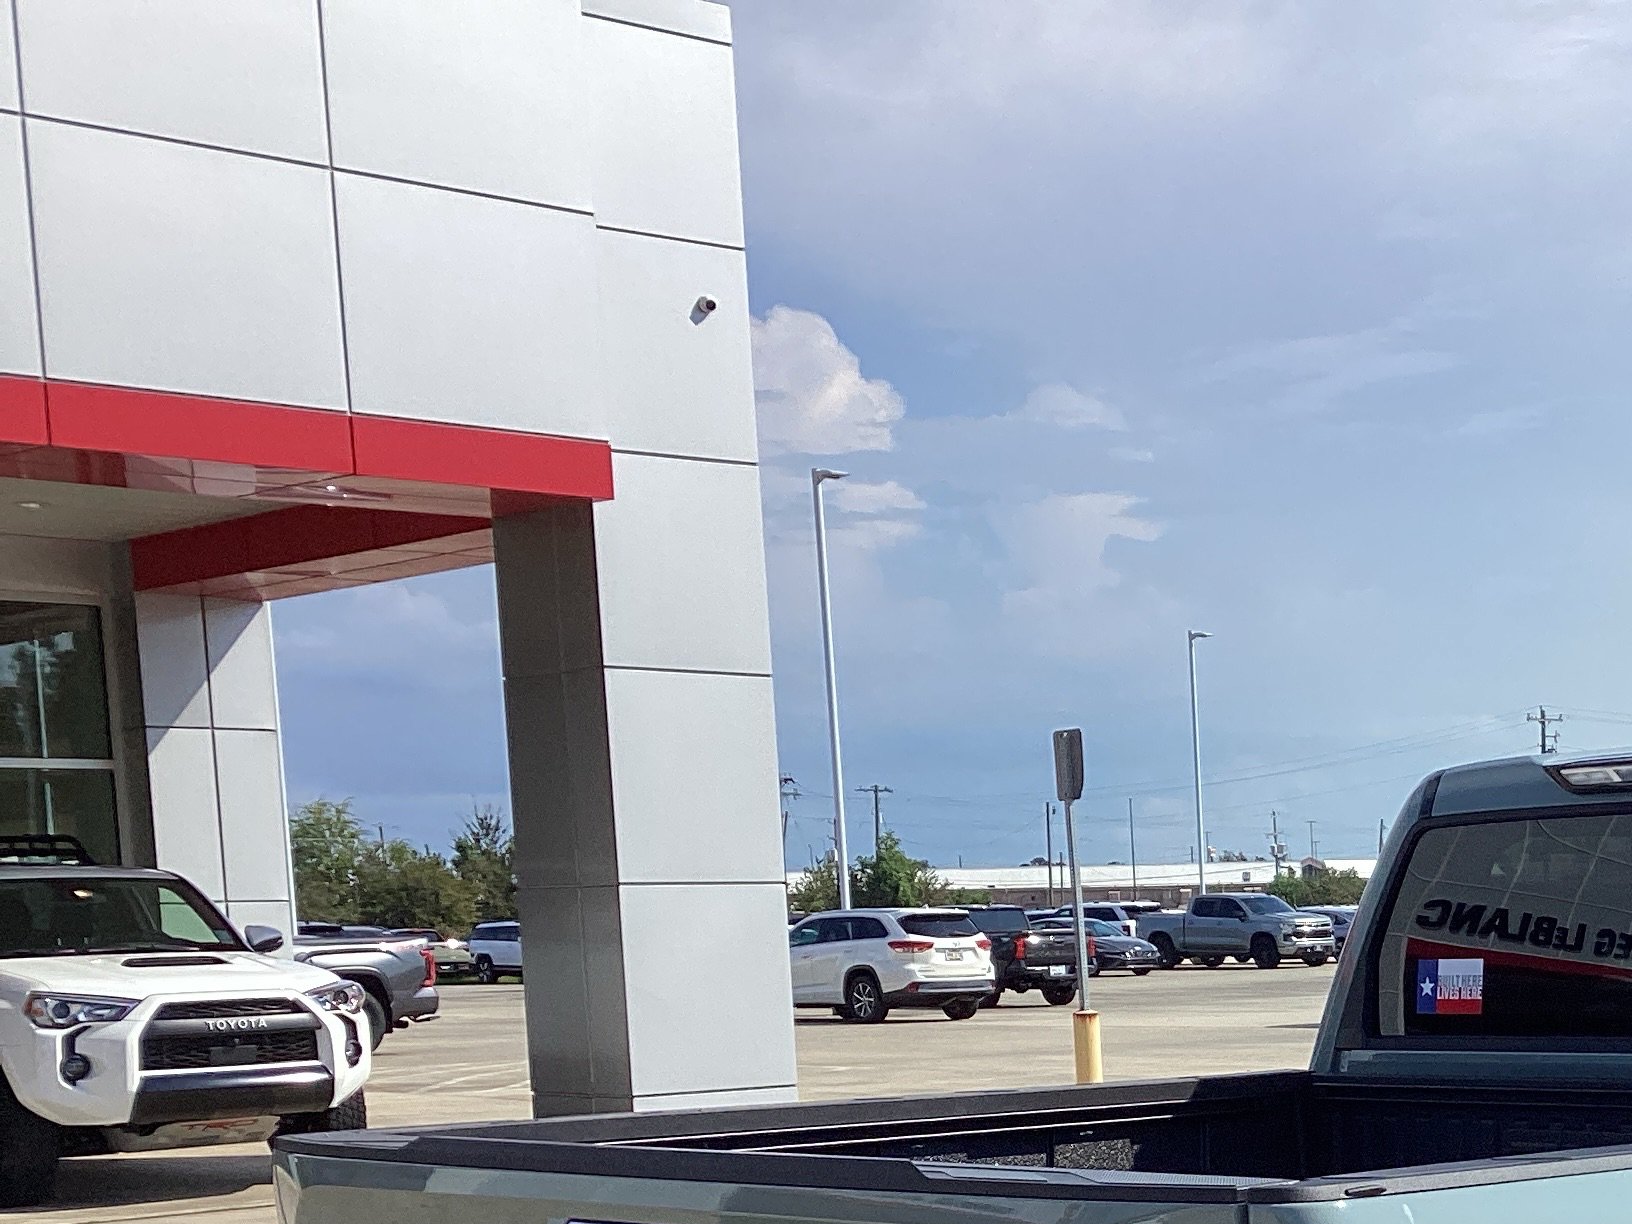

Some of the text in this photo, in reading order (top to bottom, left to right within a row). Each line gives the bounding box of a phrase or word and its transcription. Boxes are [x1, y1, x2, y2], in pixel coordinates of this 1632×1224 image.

[1438, 975, 1482, 987] BUILT HERE
[1437, 987, 1482, 999] LIVES HERE
[205, 1017, 268, 1032] TOYOTA
